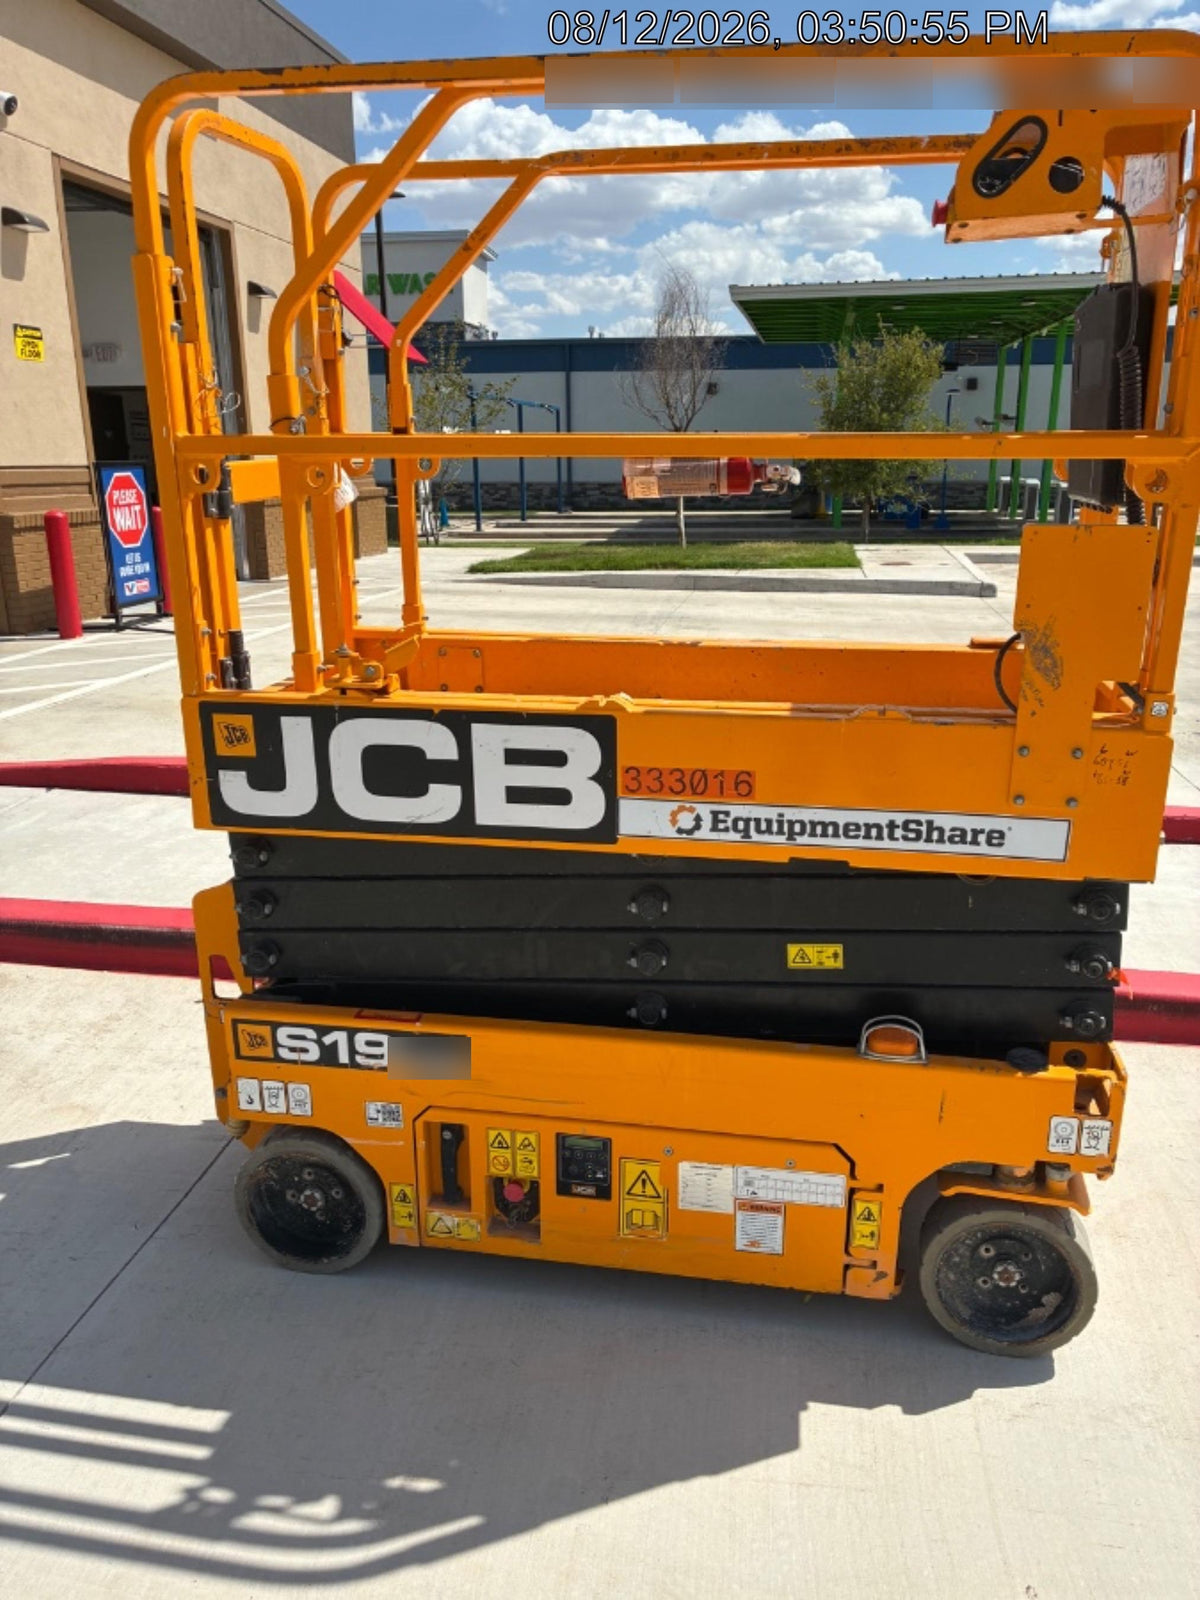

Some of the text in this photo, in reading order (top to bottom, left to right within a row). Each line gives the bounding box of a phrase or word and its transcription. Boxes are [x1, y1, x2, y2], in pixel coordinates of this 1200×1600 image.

[112, 489, 138, 505] PLEASE
[113, 504, 142, 532] WAIT
[224, 723, 251, 748] JCB
[218, 716, 605, 829] JCB
[623, 766, 754, 797] 333016
[709, 811, 1006, 848] EquipmentShare
